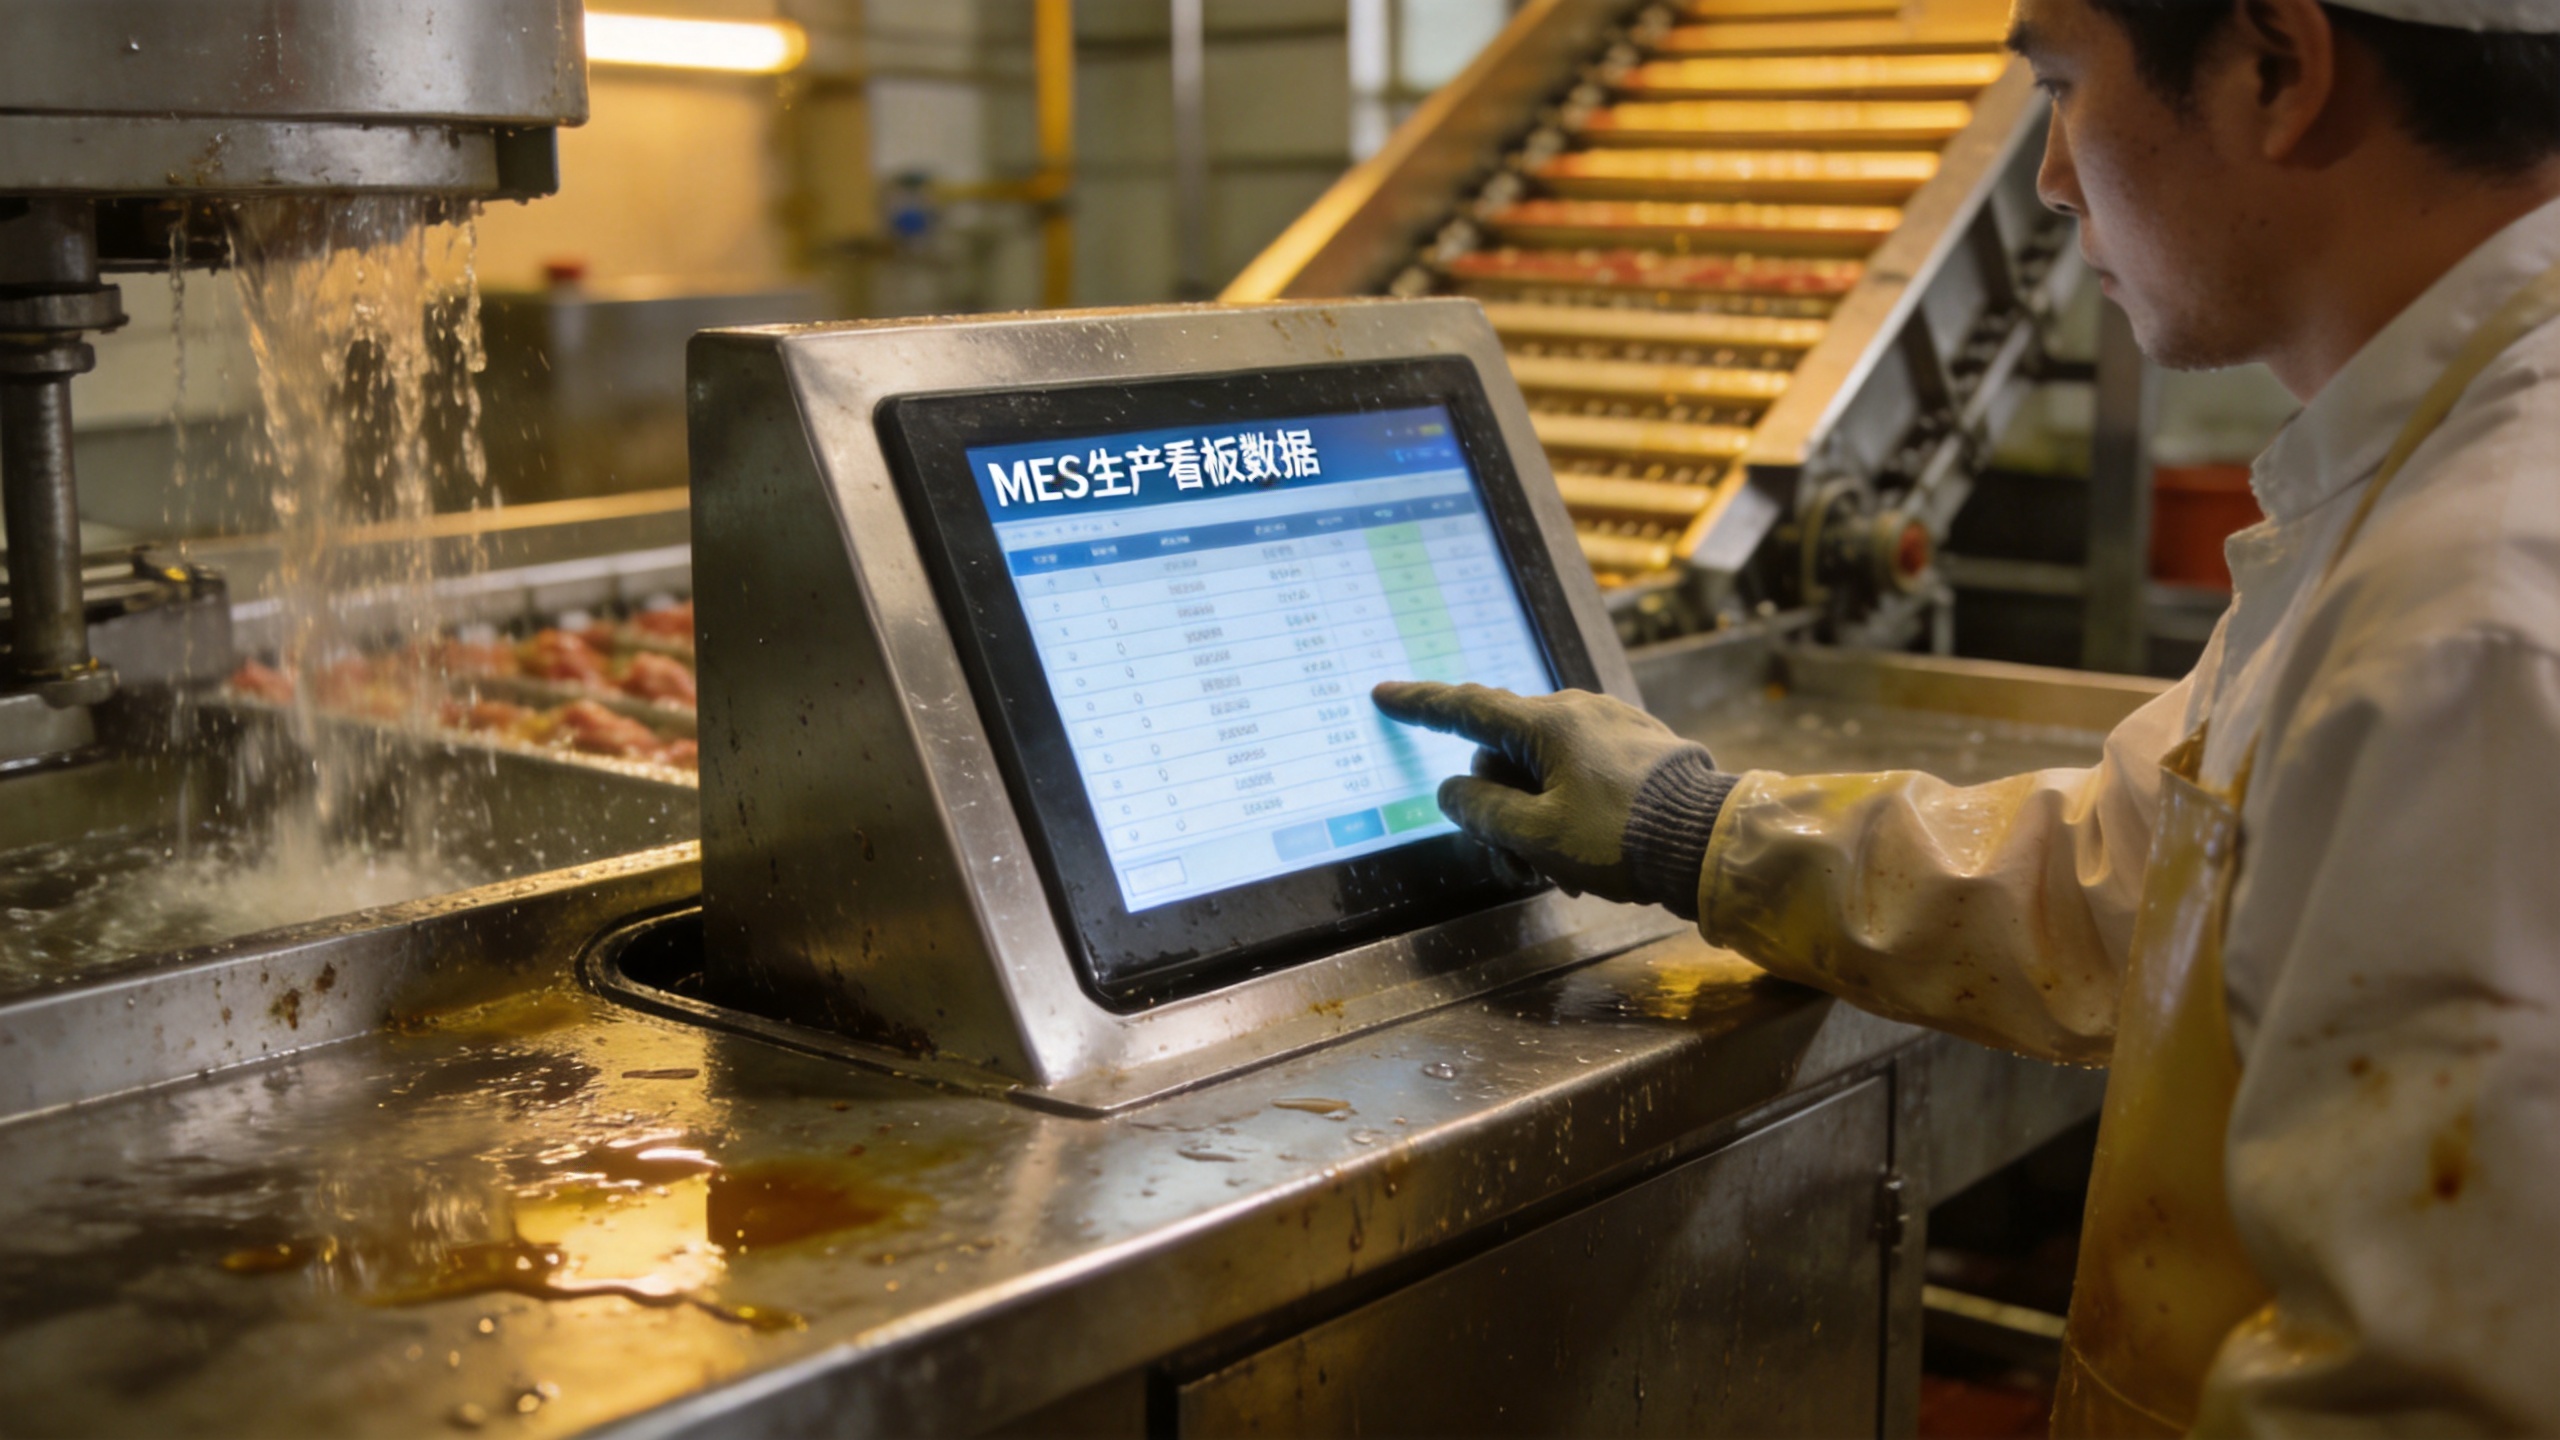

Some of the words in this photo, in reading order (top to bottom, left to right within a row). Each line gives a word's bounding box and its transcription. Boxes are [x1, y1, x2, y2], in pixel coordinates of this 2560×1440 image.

[987, 429, 1321, 507] MES生产看板数据
